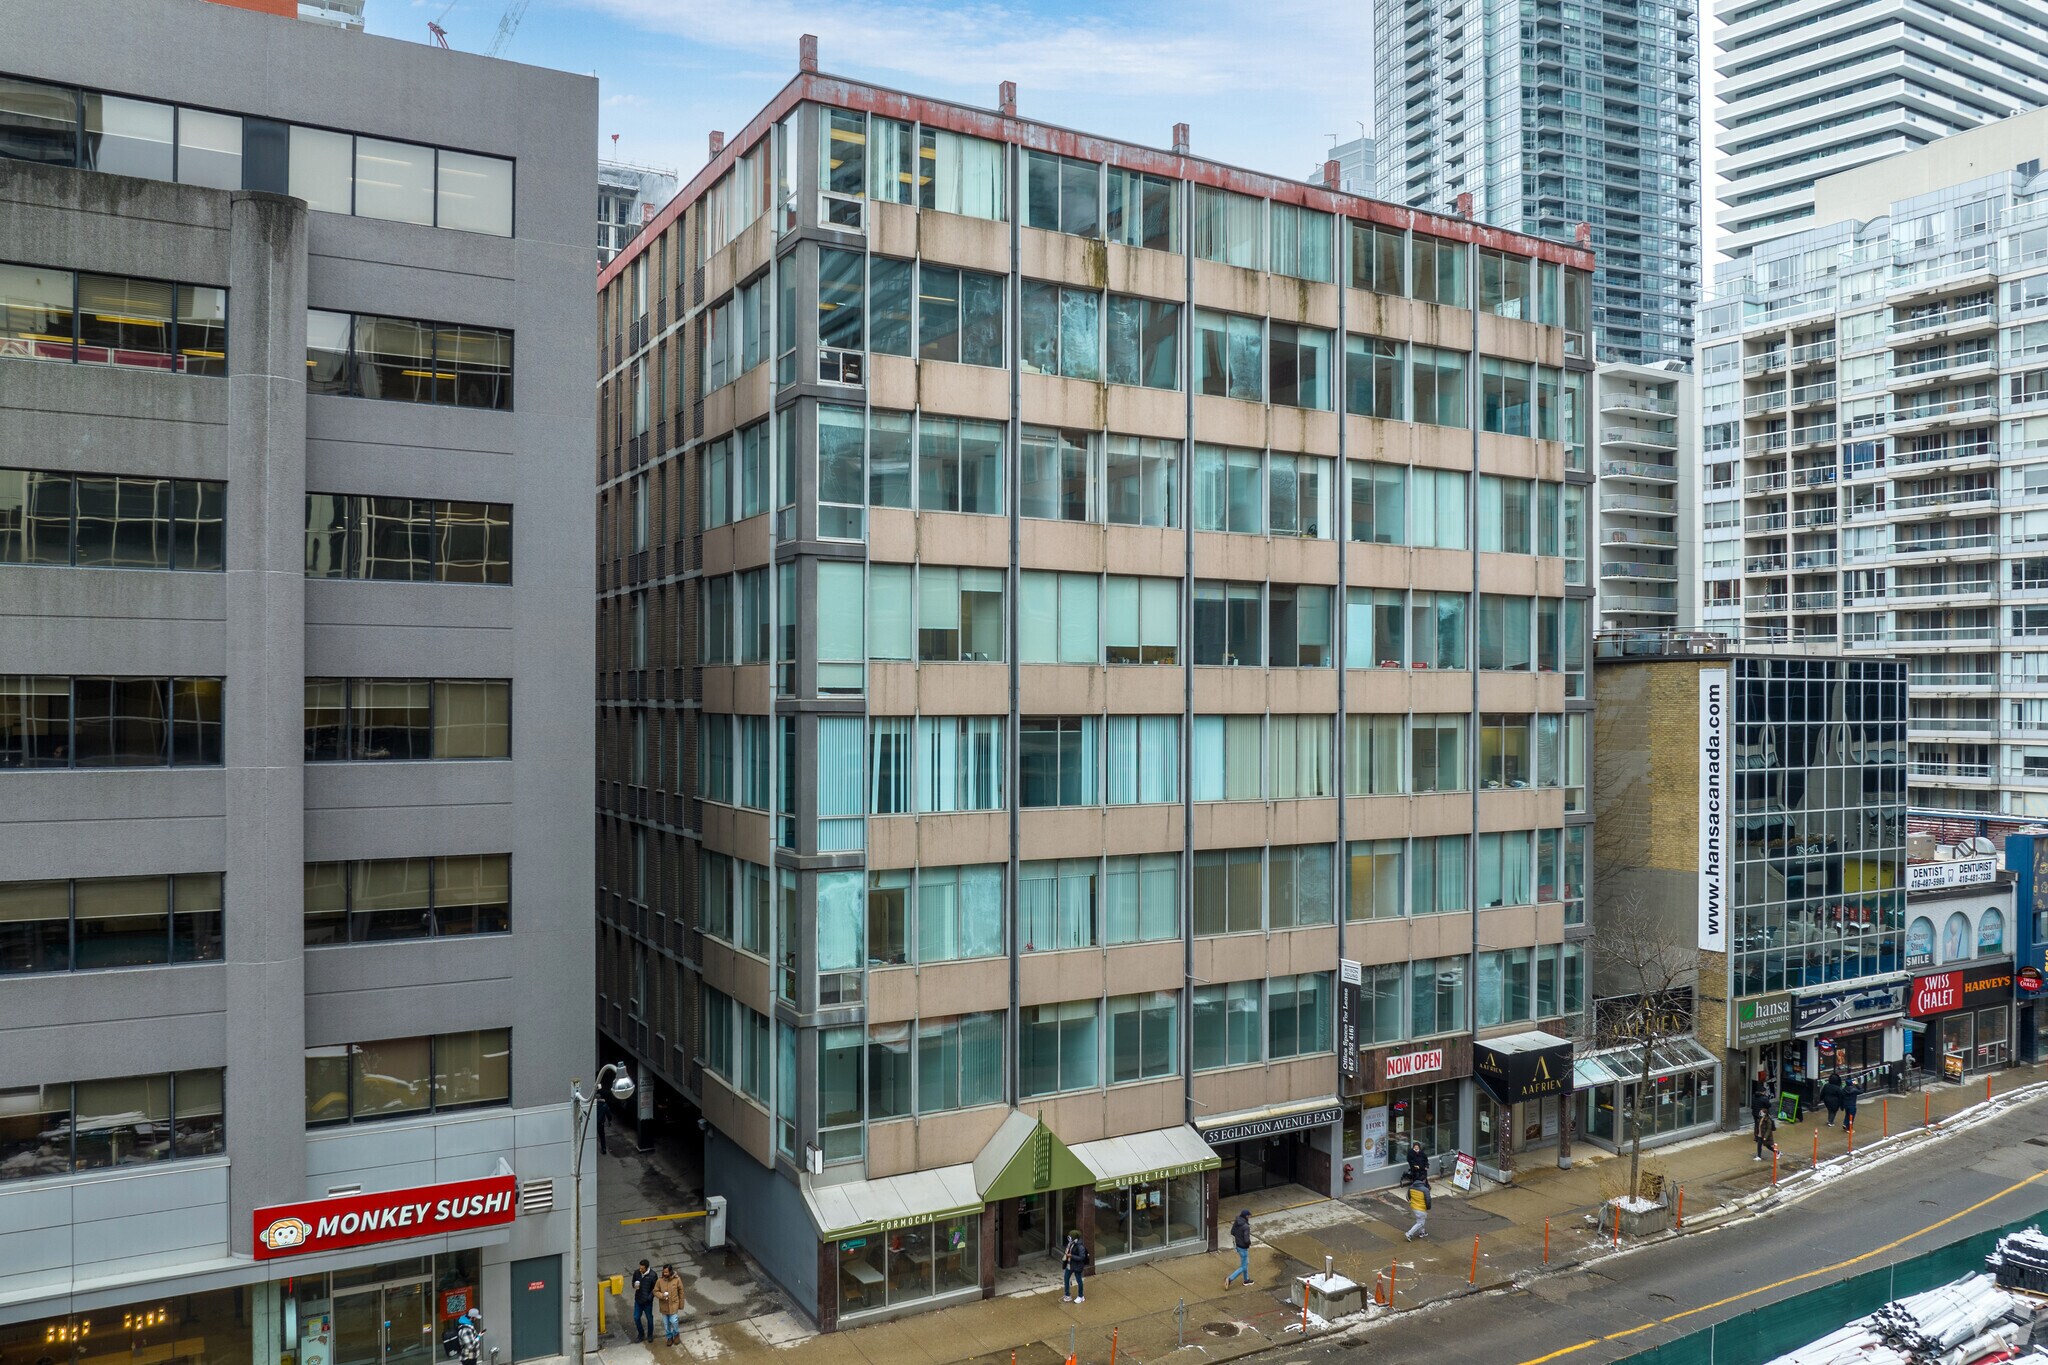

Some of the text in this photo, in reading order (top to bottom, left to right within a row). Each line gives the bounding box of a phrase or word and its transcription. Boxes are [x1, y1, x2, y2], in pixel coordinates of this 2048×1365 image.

[1705, 684, 1720, 936] www.hansacanada.com
[1913, 866, 1943, 878] DENTIST
[1959, 861, 1992, 873] DENTURIST
[1906, 954, 1930, 966] SMILE
[1924, 974, 1950, 991] SWISS
[1964, 976, 2011, 993] HARVEY'S
[1755, 1001, 1789, 1019] hansa
[1917, 989, 1954, 1013] CHALET
[1740, 1014, 1790, 1030] language centre
[1387, 1051, 1441, 1076] NOW OPEN
[1521, 1081, 1562, 1095] AAFRIEN
[1208, 1109, 1338, 1143] 55 EGLINTON AVENUE EAST
[1115, 1163, 1203, 1187] BUBBLE TEA HOUSE
[316, 1190, 512, 1239] MONKEY SUSHI
[880, 1213, 934, 1231] FORMOCHA
